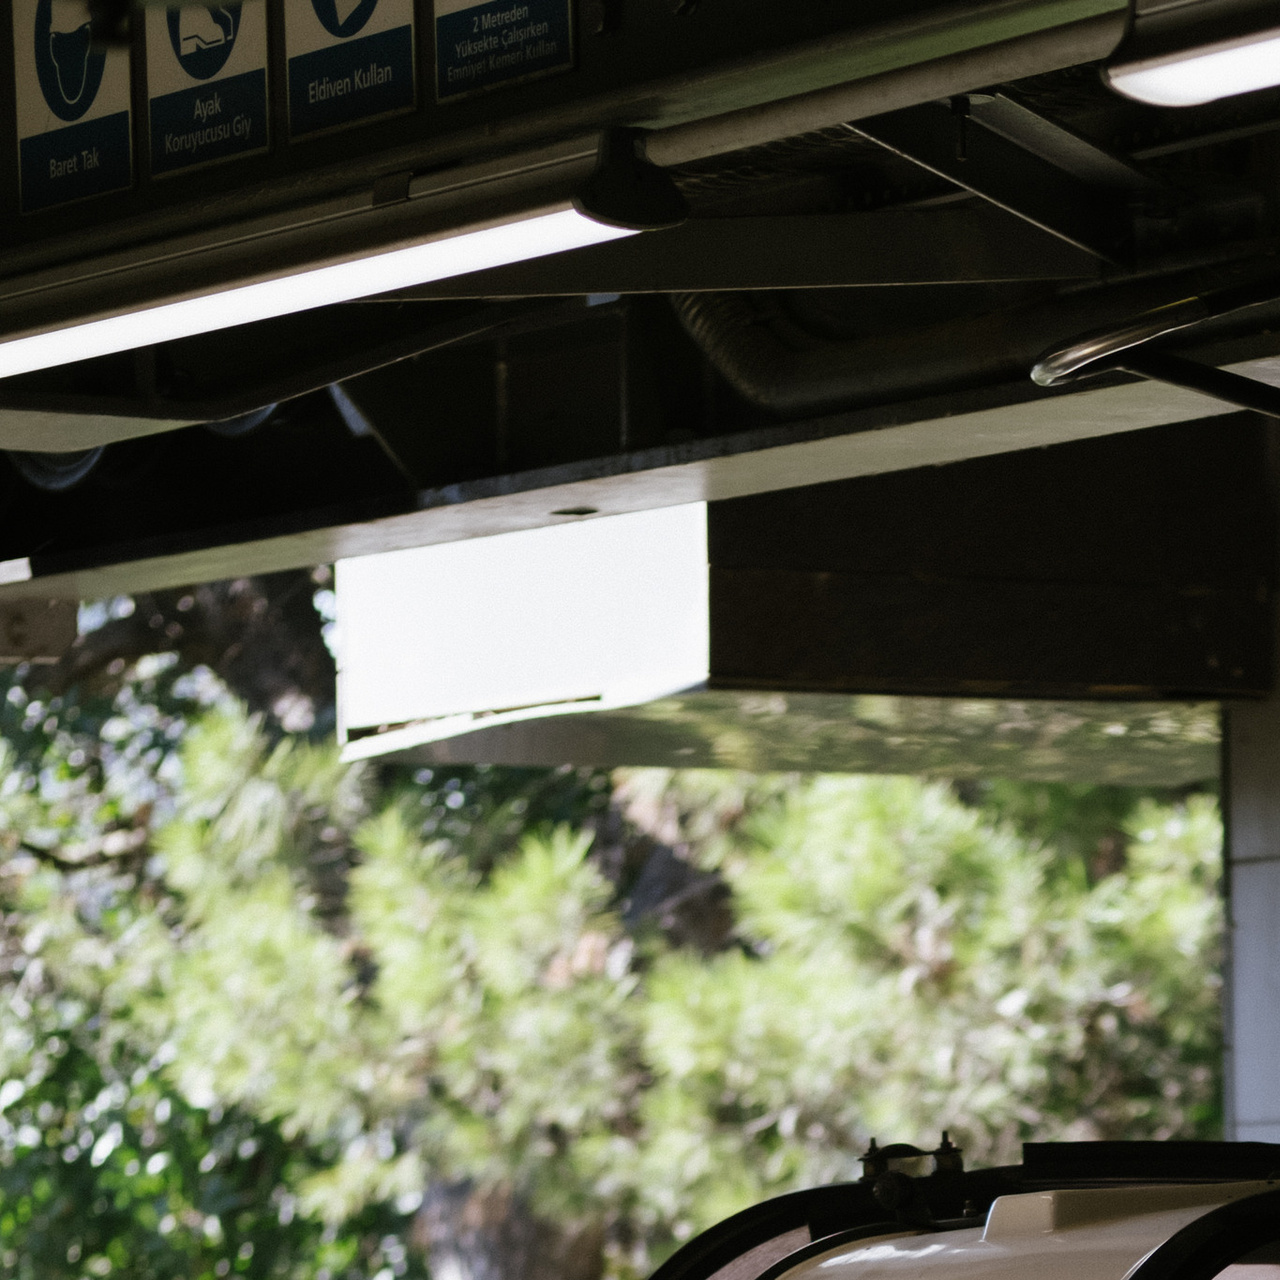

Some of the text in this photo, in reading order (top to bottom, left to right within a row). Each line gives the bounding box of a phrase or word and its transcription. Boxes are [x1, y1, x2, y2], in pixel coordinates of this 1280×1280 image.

[473, 4, 529, 33] 2 Metreden
[455, 21, 549, 59] Yüksekte Çalışırken
[447, 60, 486, 83] Emniyet
[526, 40, 556, 61] Kullan
[308, 62, 393, 104] Eldiven Kullan
[193, 92, 222, 124] Ayak
[164, 113, 252, 155] Koruyucusu Giy
[49, 147, 100, 180] Baret Tak
